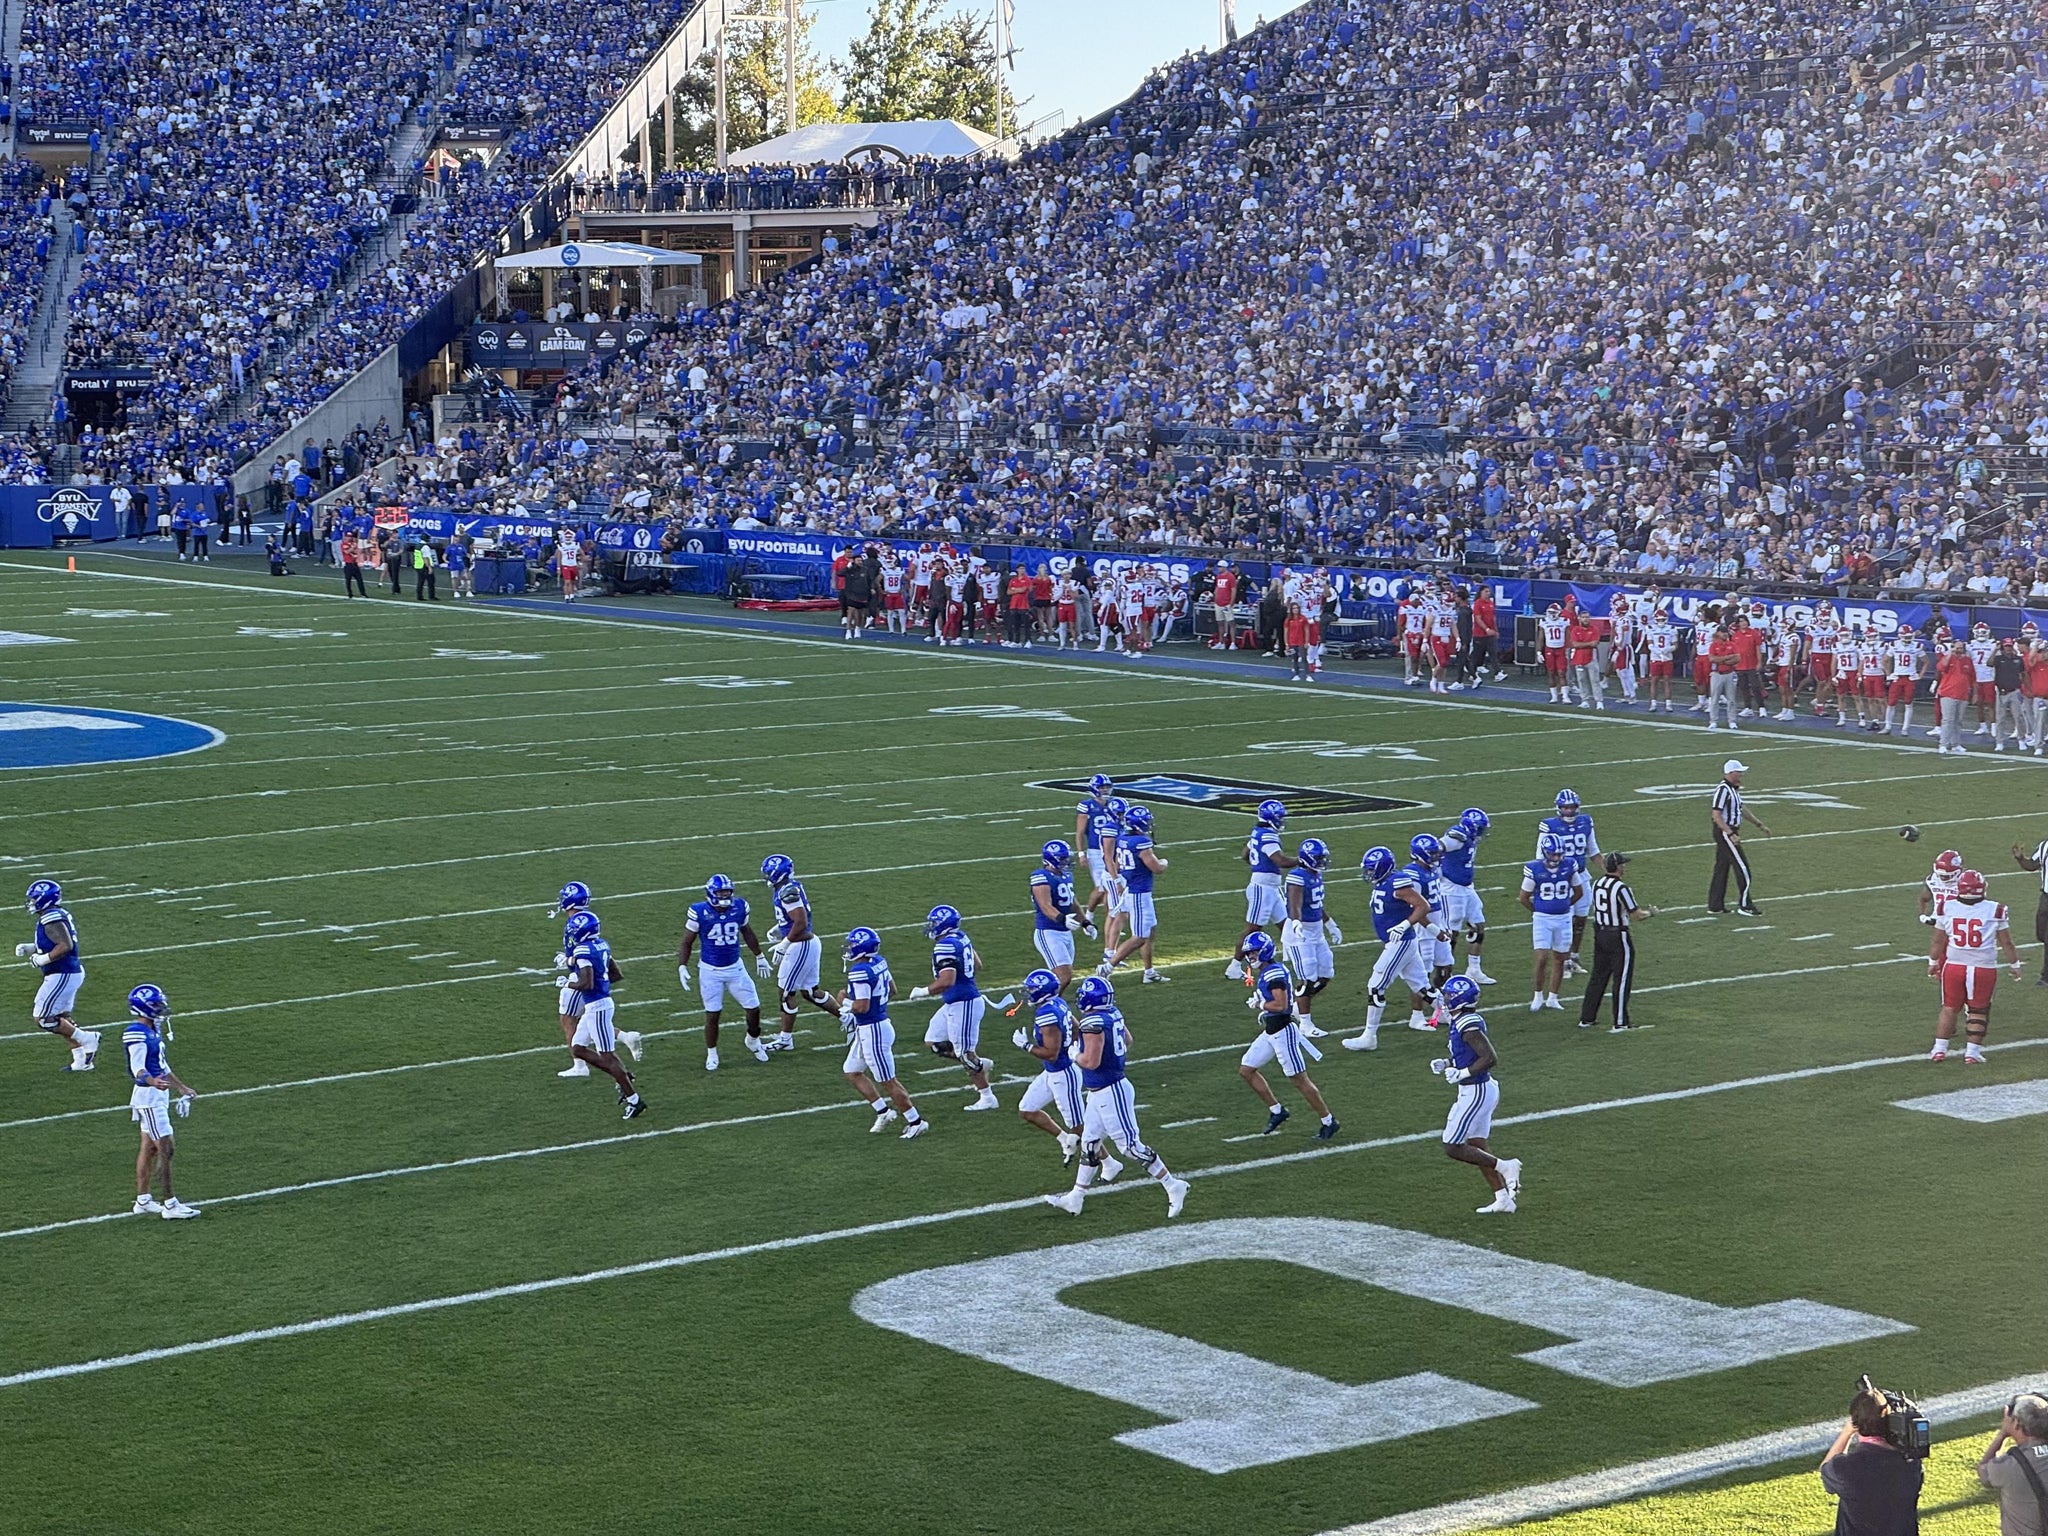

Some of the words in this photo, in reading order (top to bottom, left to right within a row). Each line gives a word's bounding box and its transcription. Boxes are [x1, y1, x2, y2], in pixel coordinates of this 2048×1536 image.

[540, 340, 587, 351] GAMEDAY
[71, 379, 100, 389] Portal
[101, 379, 110, 389] Y
[58, 494, 81, 502] BYU
[37, 502, 102, 522] CREAMERY
[405, 518, 442, 530] OUGS
[728, 538, 755, 552] BYU
[756, 540, 824, 556] FOOTBALL
[1549, 627, 1561, 640] 10
[1658, 635, 1665, 648] 9
[1977, 651, 1985, 665] 7
[1563, 833, 1587, 857] 59
[1595, 888, 1608, 912] C
[707, 921, 739, 946] 48
[1953, 918, 1983, 947] 56
